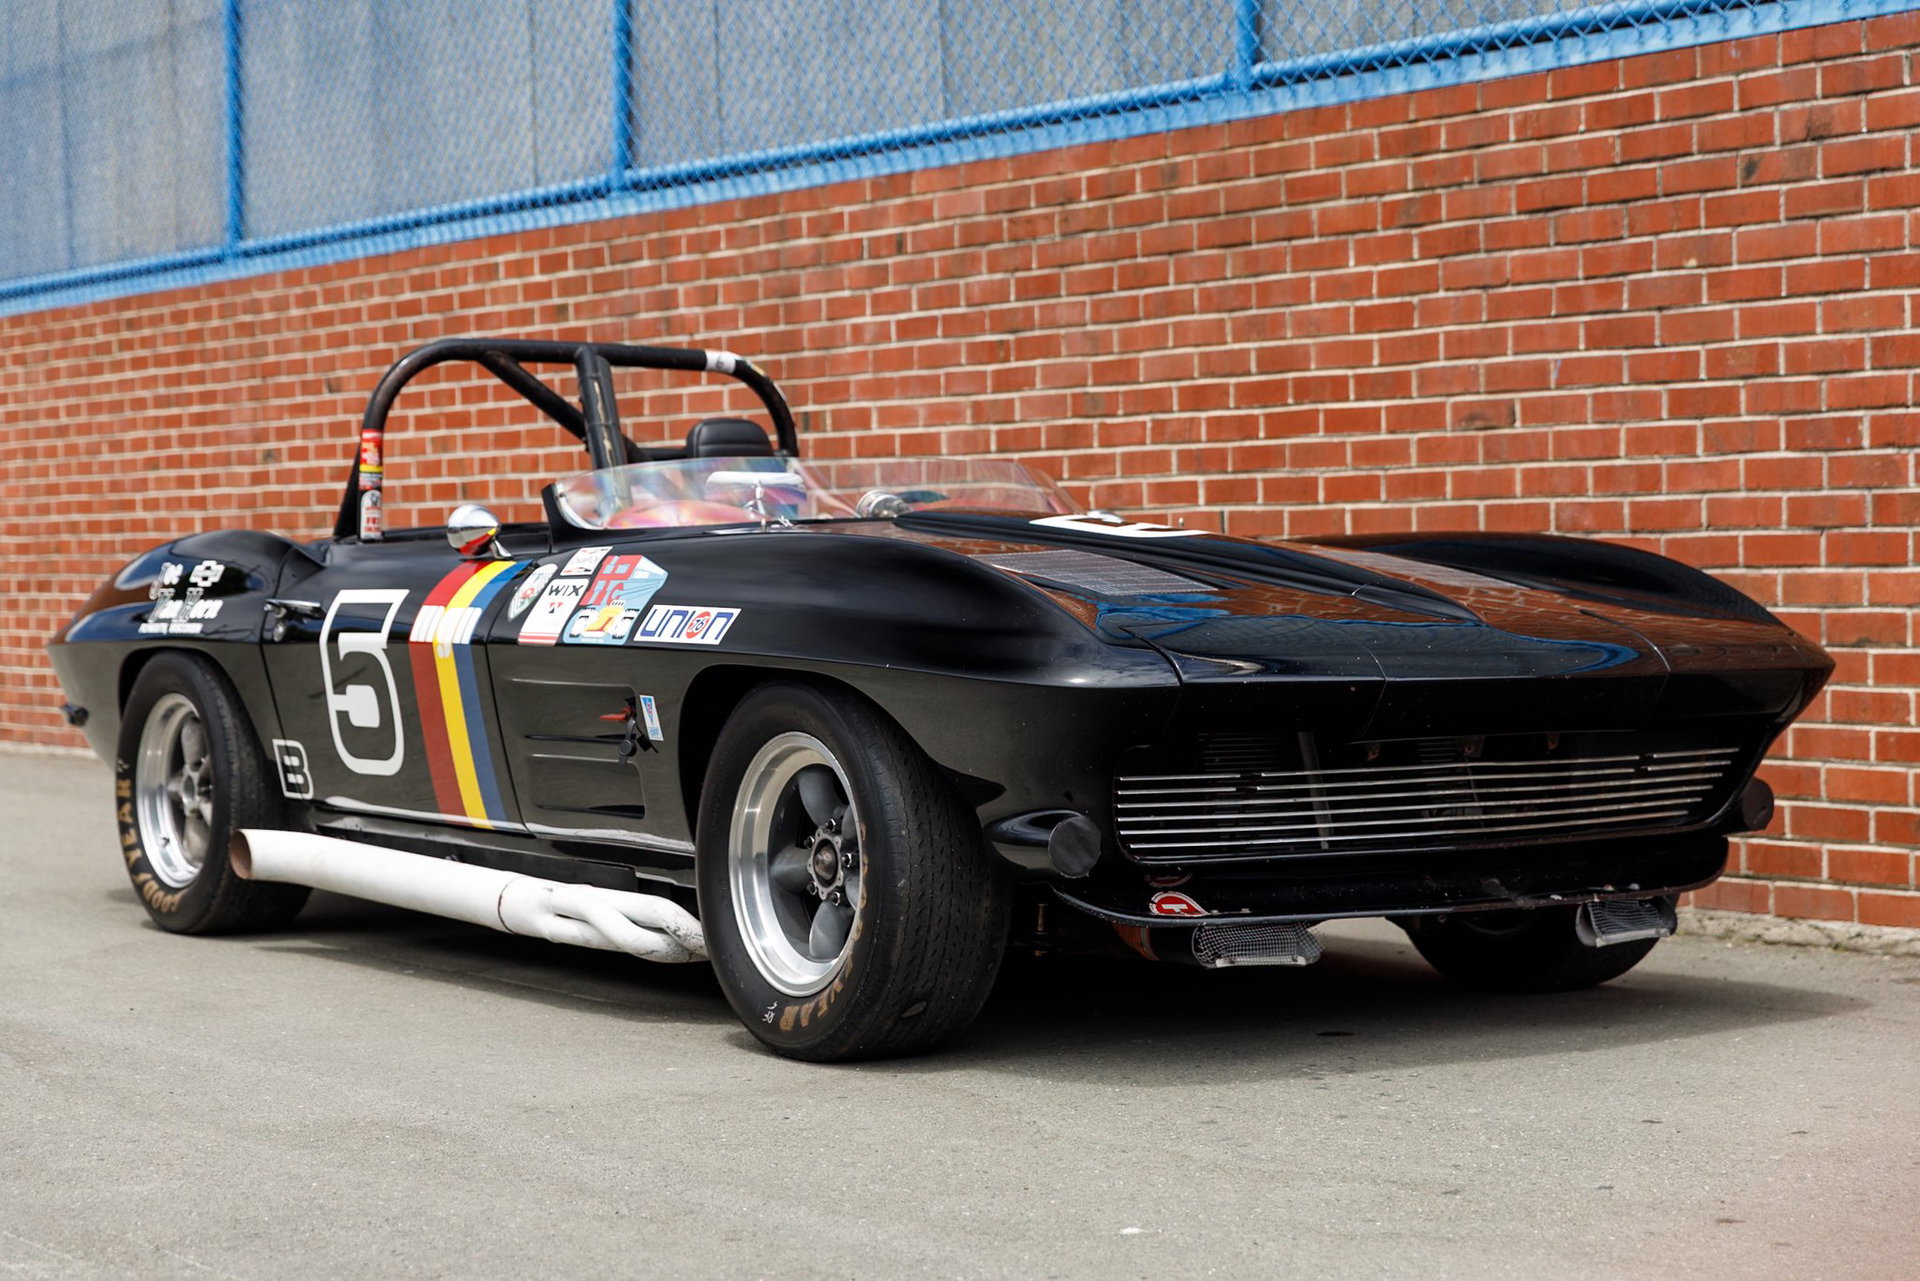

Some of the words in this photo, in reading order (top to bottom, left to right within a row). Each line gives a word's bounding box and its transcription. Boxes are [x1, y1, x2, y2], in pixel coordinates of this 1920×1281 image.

[548, 584, 584, 597] WIX
[689, 617, 709, 633] 76
[319, 588, 410, 776] 5
[272, 738, 314, 801] B
